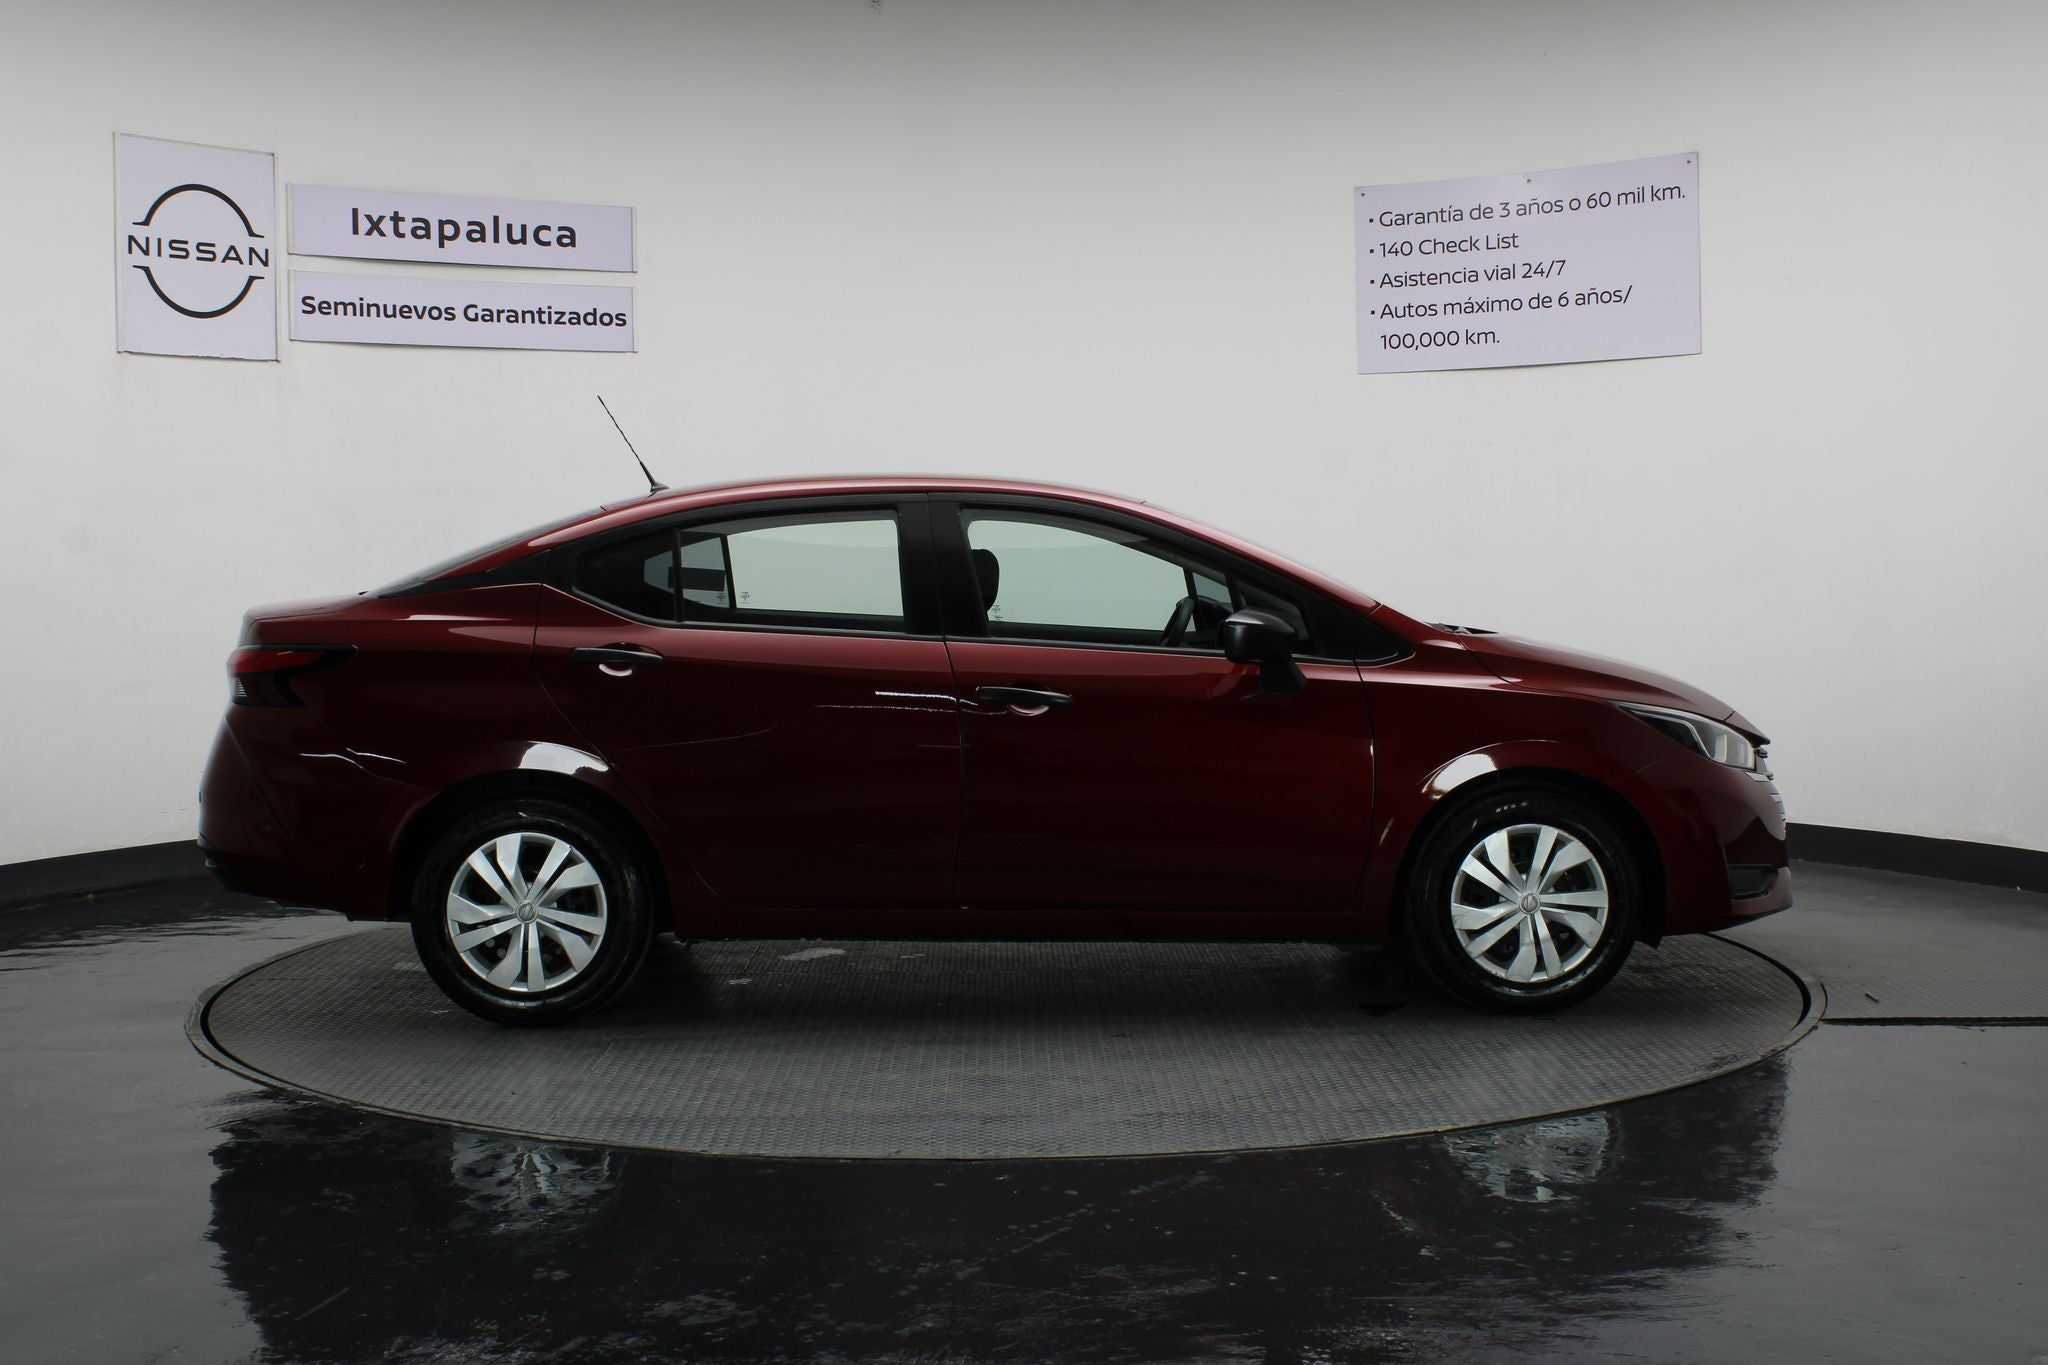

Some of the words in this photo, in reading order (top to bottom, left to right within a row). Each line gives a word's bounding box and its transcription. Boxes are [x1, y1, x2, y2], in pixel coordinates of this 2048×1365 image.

[1379, 205, 1463, 227] Garantía
[1470, 204, 1493, 220] de
[1500, 202, 1510, 217] 3
[1516, 198, 1563, 216] años
[1569, 198, 1581, 211] o
[1587, 192, 1611, 209] 60
[1618, 186, 1644, 206] mil
[1651, 185, 1685, 202] km.
[352, 208, 576, 248] Ixtapaluca
[128, 234, 269, 267] NISSAN
[1380, 241, 1413, 257] 140
[1419, 236, 1480, 255] Check
[1486, 233, 1519, 250] List
[1380, 267, 1478, 288] Asistencia
[1484, 264, 1515, 281] vial
[1522, 260, 1566, 278] 24/7
[302, 296, 456, 321] Seminuevos
[463, 304, 627, 327] Garantizados
[1380, 303, 1437, 319] Autos
[1444, 297, 1522, 315] máximo
[1528, 293, 1552, 309] de
[1558, 291, 1569, 307] 6
[1575, 285, 1632, 306] años/
[1380, 331, 1459, 350] 100,000
[1466, 329, 1499, 345] km.
